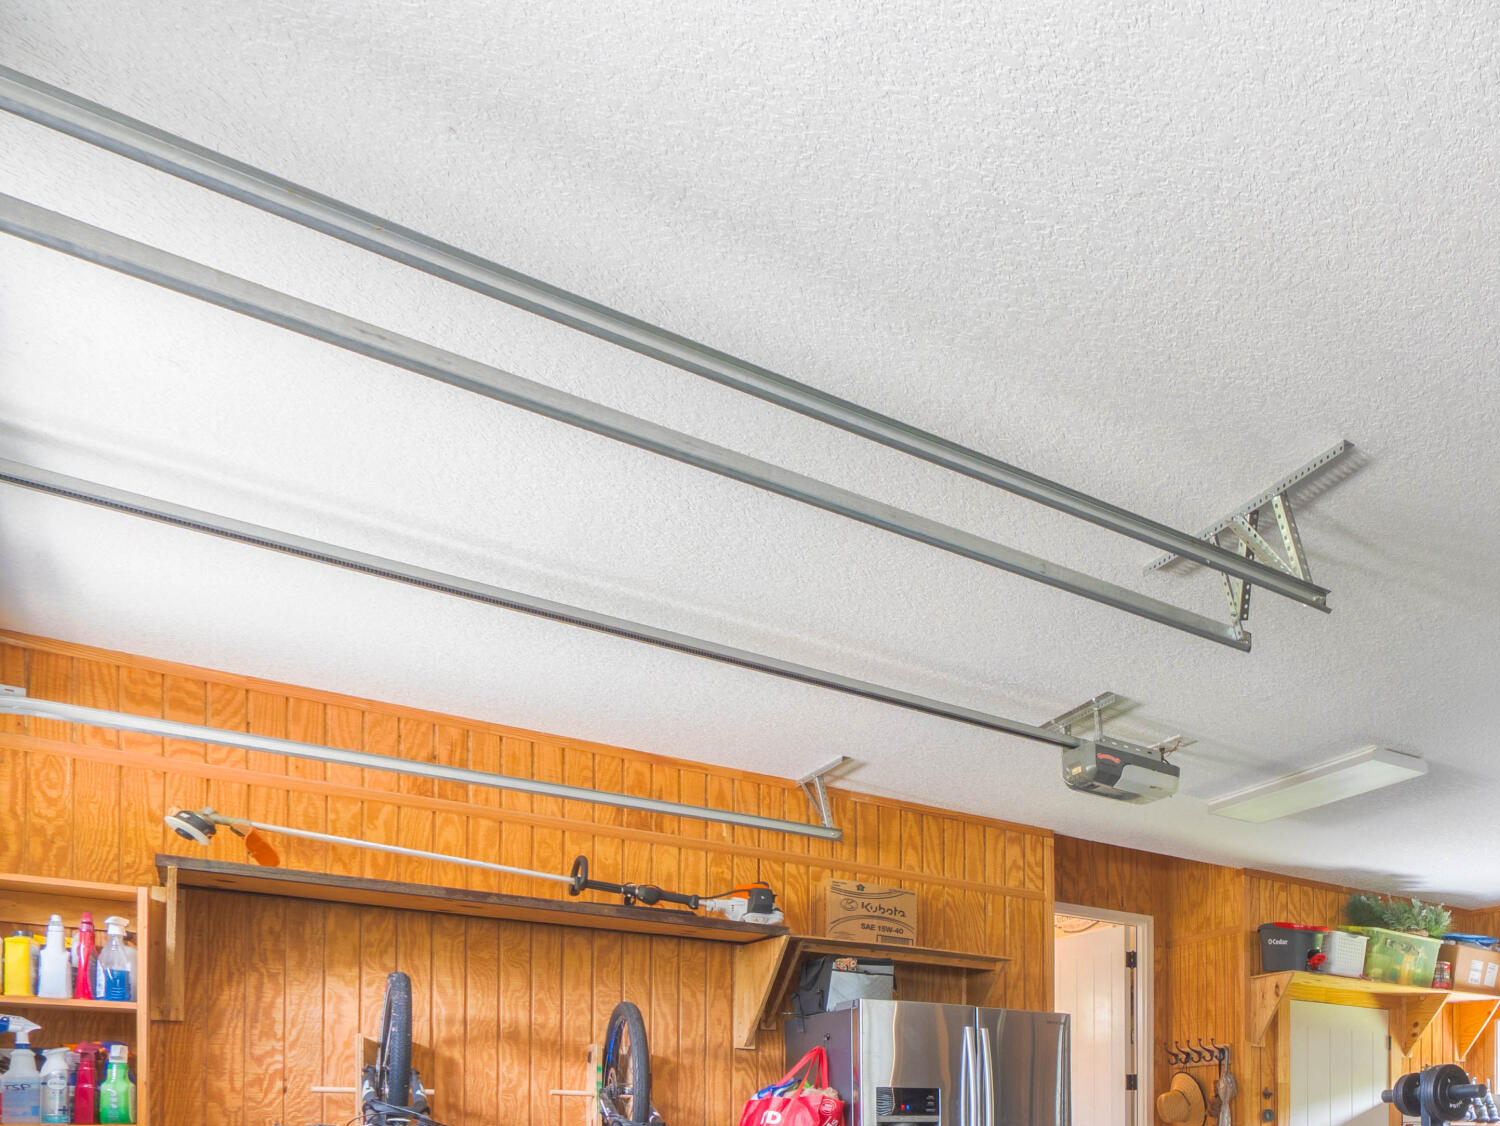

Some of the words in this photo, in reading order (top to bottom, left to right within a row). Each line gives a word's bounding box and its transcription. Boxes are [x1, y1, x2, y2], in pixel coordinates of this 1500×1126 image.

[861, 901, 906, 918] Kubota
[861, 922, 876, 931] SAE
[878, 925, 904, 934] 15W-40
